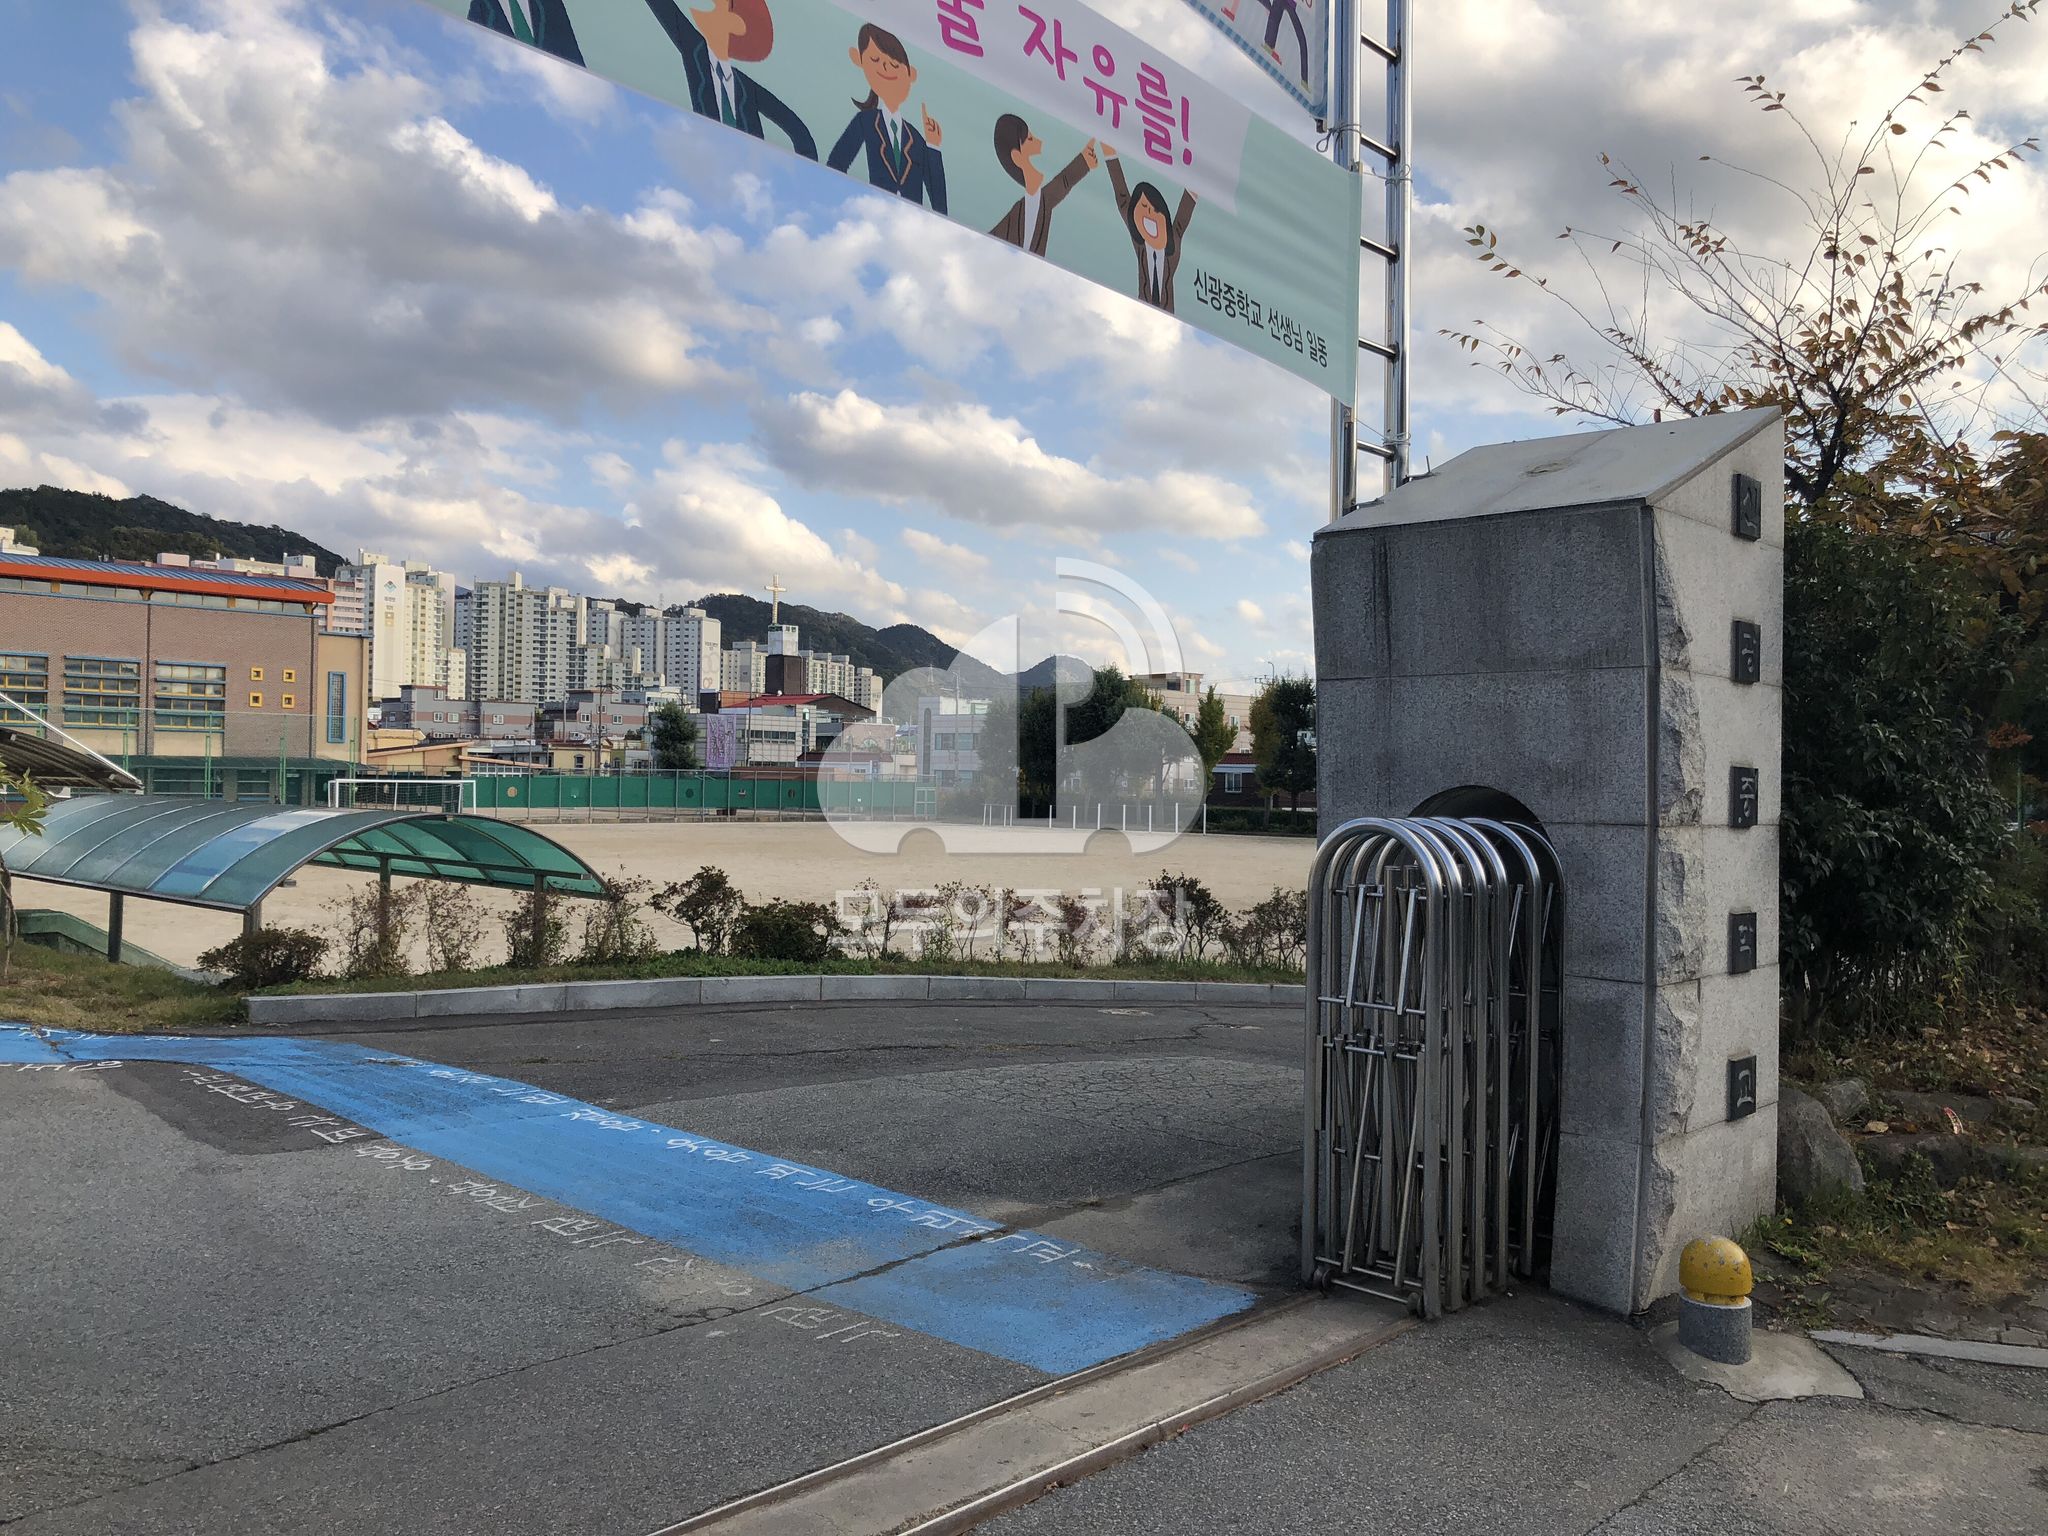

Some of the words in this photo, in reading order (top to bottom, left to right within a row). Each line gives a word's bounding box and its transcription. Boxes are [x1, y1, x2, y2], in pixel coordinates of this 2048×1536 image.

[1018, 5, 1192, 165] 자유를!
[1194, 268, 1264, 330] 신광중학교
[1267, 307, 1304, 354] 선생님
[1306, 330, 1328, 368] 일동
